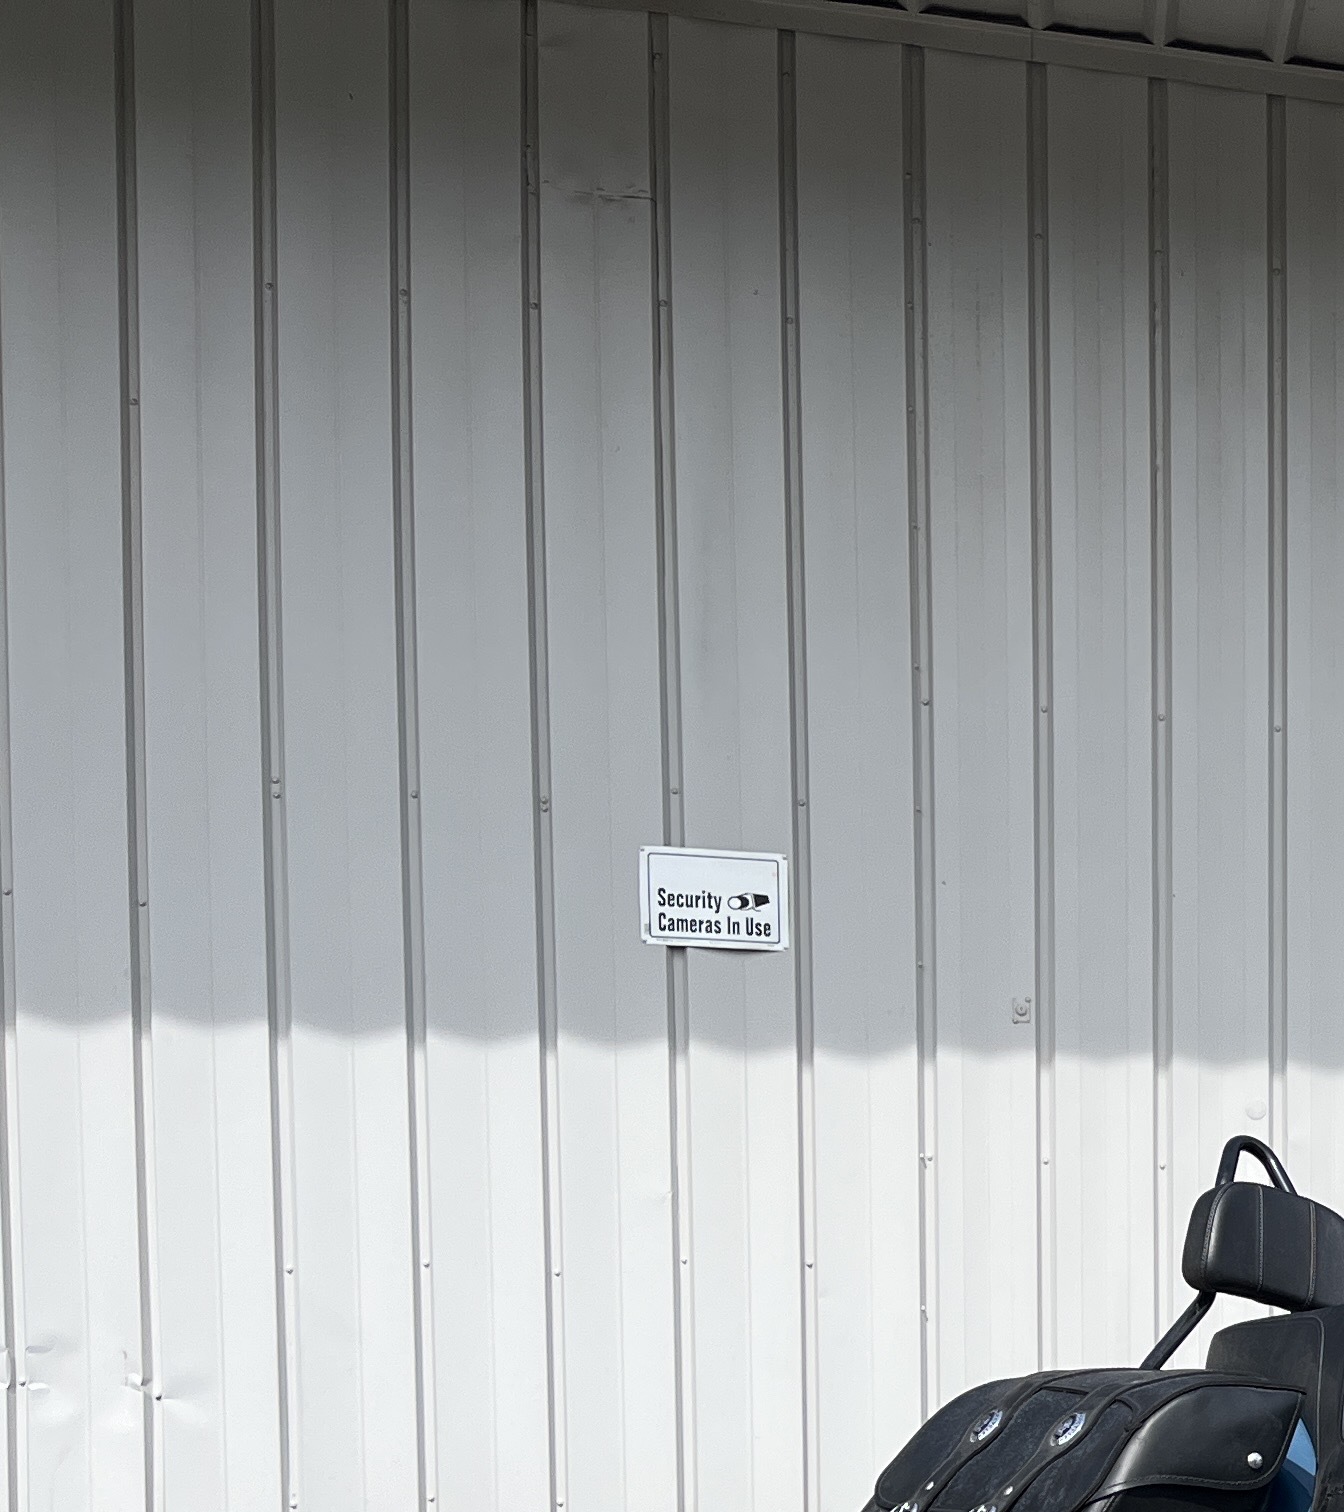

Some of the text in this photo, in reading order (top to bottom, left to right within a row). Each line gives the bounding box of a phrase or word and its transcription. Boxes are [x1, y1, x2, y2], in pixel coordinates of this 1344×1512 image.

[657, 888, 722, 914] Security
[657, 912, 771, 937] Cameras In Use
